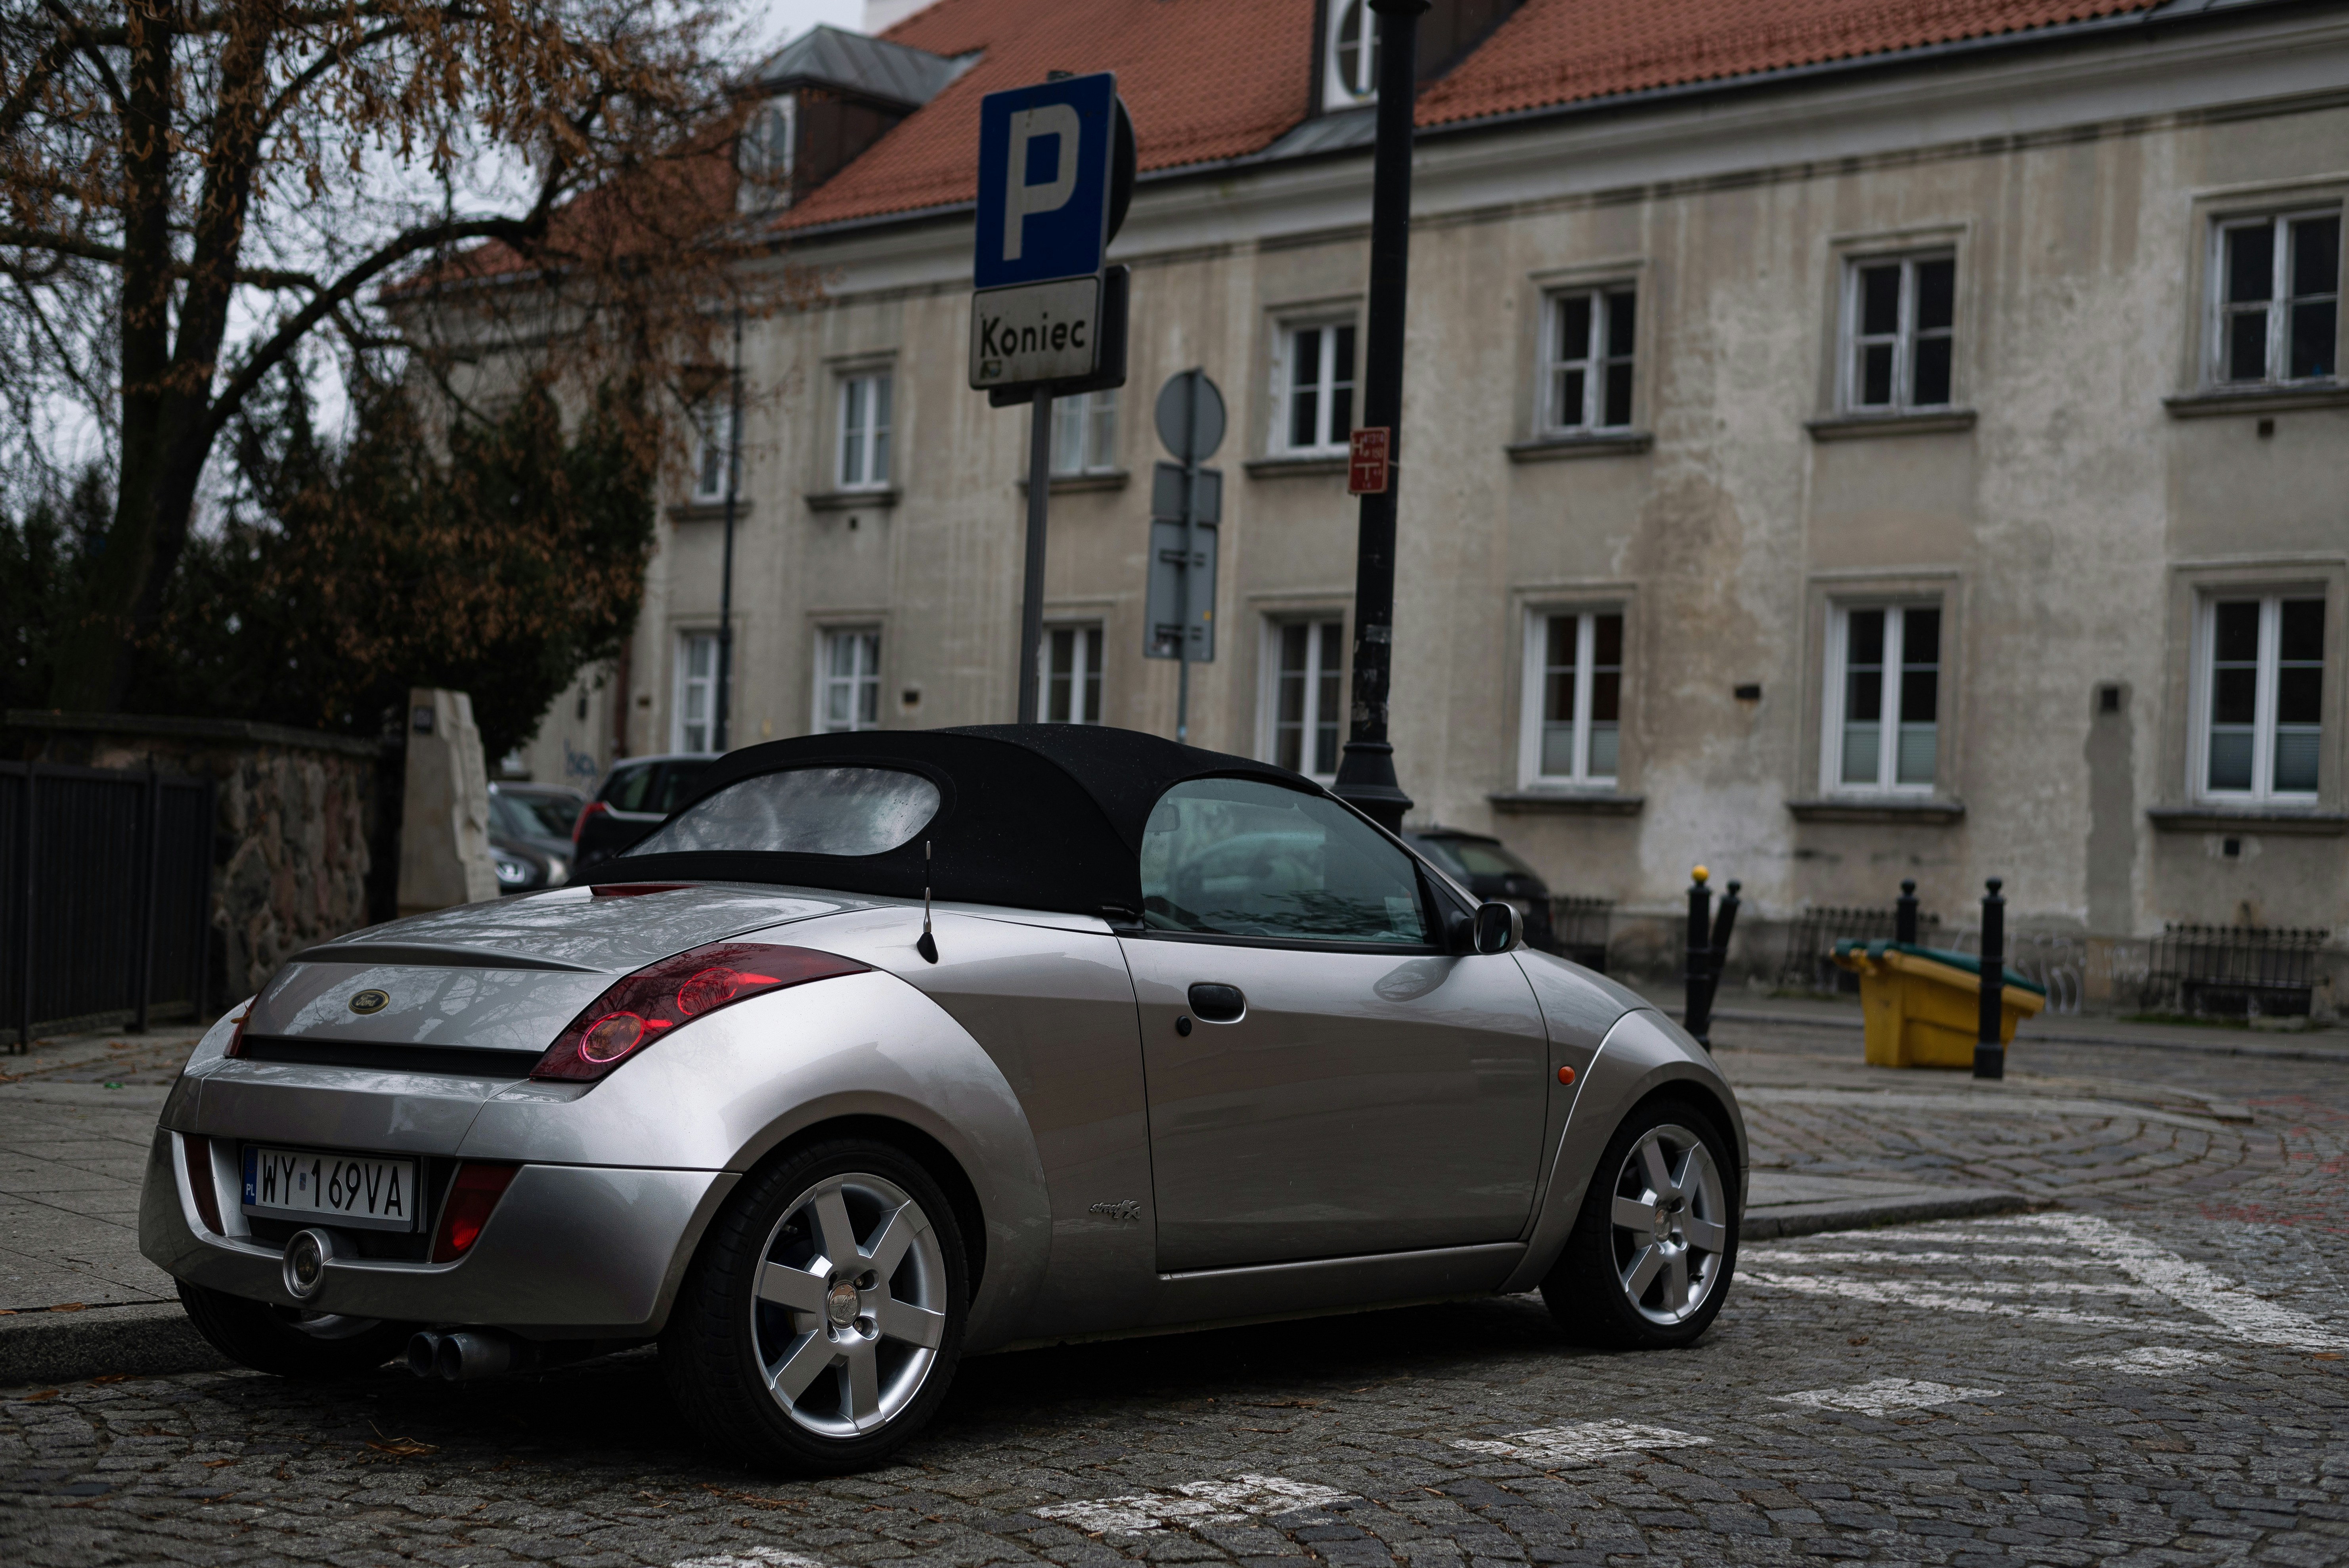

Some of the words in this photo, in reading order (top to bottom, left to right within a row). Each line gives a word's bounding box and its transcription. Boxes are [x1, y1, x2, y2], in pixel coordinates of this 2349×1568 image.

[1003, 103, 1081, 261] P
[981, 313, 1085, 358] Koniec
[356, 994, 379, 1006] Ford
[246, 1183, 255, 1196] PL
[262, 1155, 296, 1205] WY
[311, 1159, 403, 1216] 169VA
